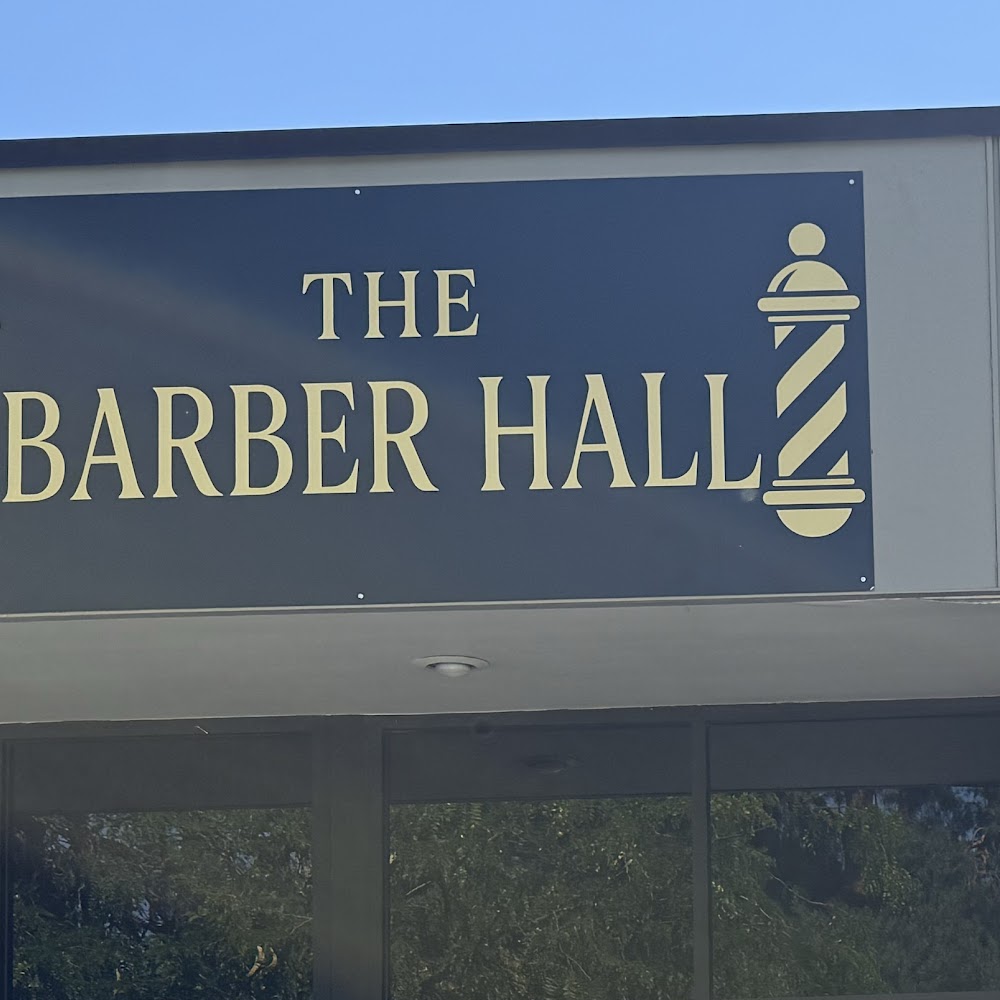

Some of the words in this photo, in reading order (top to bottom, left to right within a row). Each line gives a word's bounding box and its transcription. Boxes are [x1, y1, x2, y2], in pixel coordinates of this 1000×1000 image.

[302, 268, 480, 340] THE
[1, 380, 440, 503] BARBER
[478, 372, 763, 491] HALL
